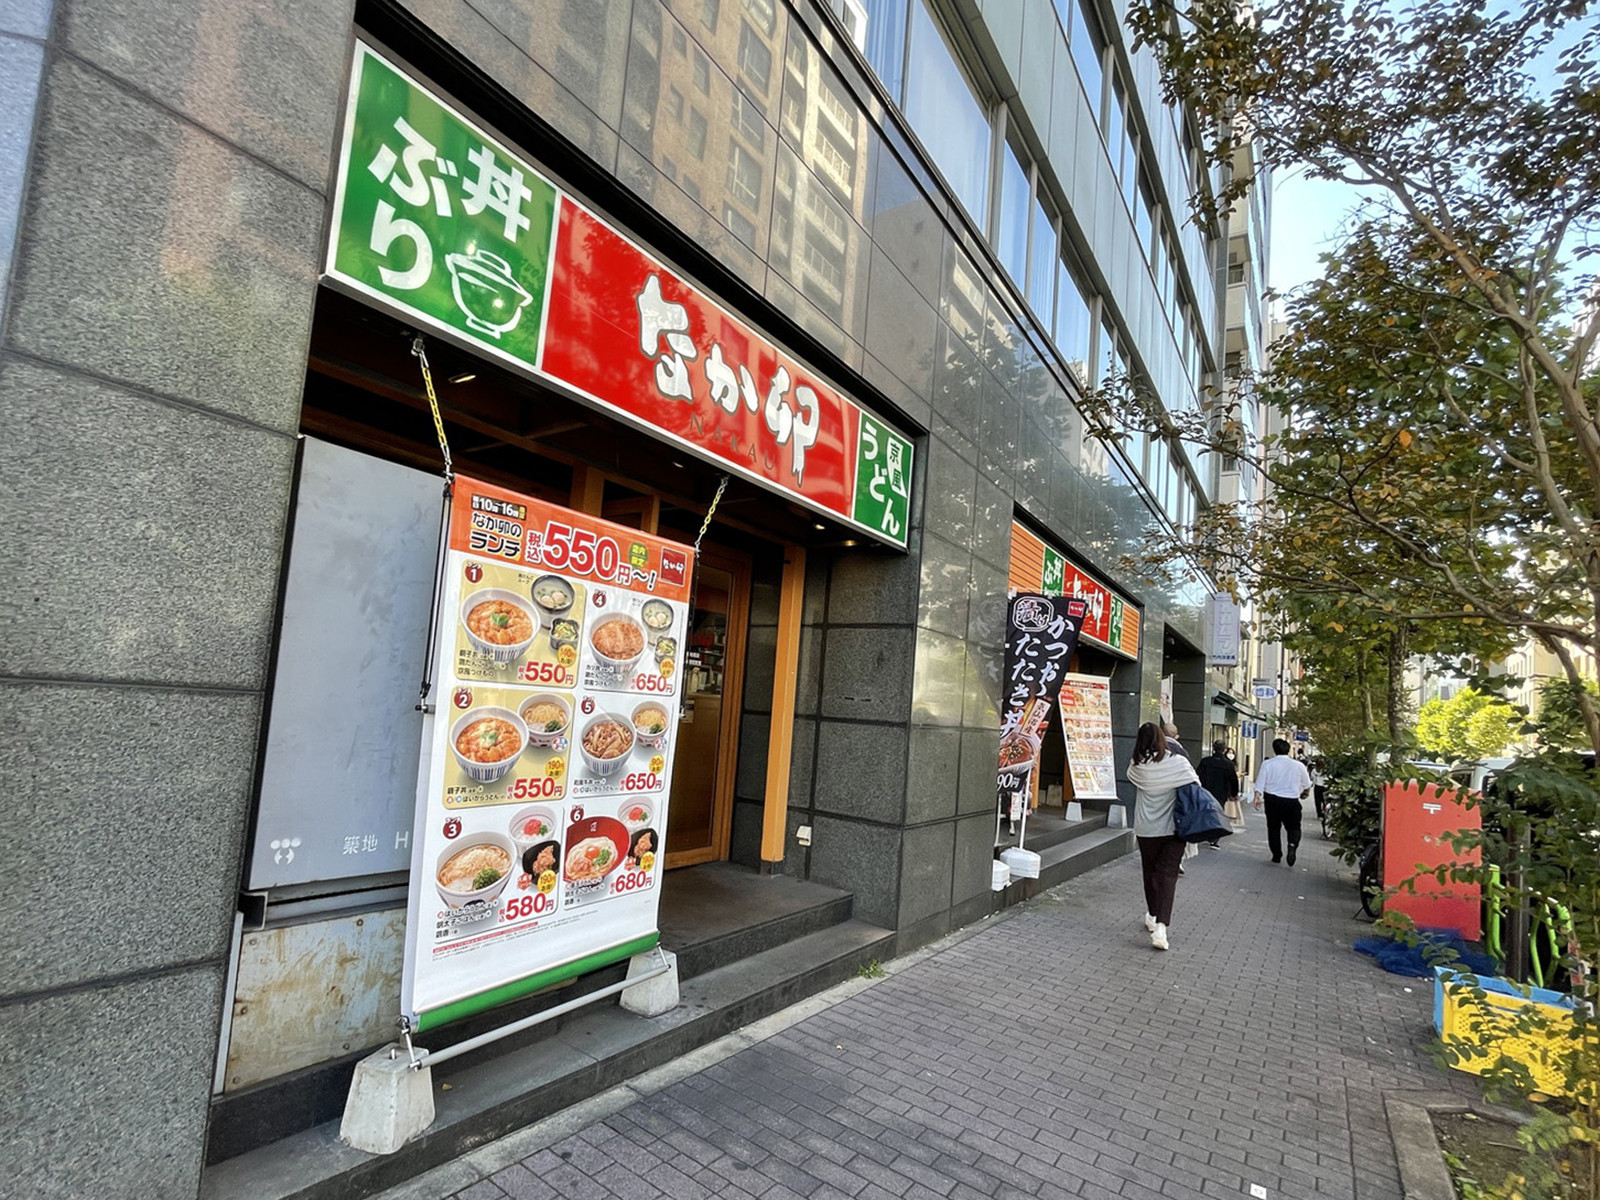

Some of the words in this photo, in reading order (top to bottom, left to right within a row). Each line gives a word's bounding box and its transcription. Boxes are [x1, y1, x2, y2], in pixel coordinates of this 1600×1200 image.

[637, 274, 820, 487] なか卯
[689, 412, 776, 470] NAKAU
[862, 421, 900, 536] うどん
[473, 512, 522, 538] なか卯の
[471, 531, 521, 557] ランチ
[527, 532, 541, 562] 税込
[470, 568, 478, 581] 1
[596, 593, 603, 606] 4
[525, 661, 574, 685] 550円
[636, 673, 673, 693] 650円
[458, 694, 468, 707] 2
[584, 702, 592, 713] 5
[514, 777, 562, 799] 550円
[625, 772, 662, 791] 650円
[573, 810, 581, 821] 6
[448, 823, 457, 837] 3
[343, 834, 378, 855] 築地
[394, 831, 409, 850] H
[615, 871, 652, 893] 680円
[506, 893, 554, 920] 580円
